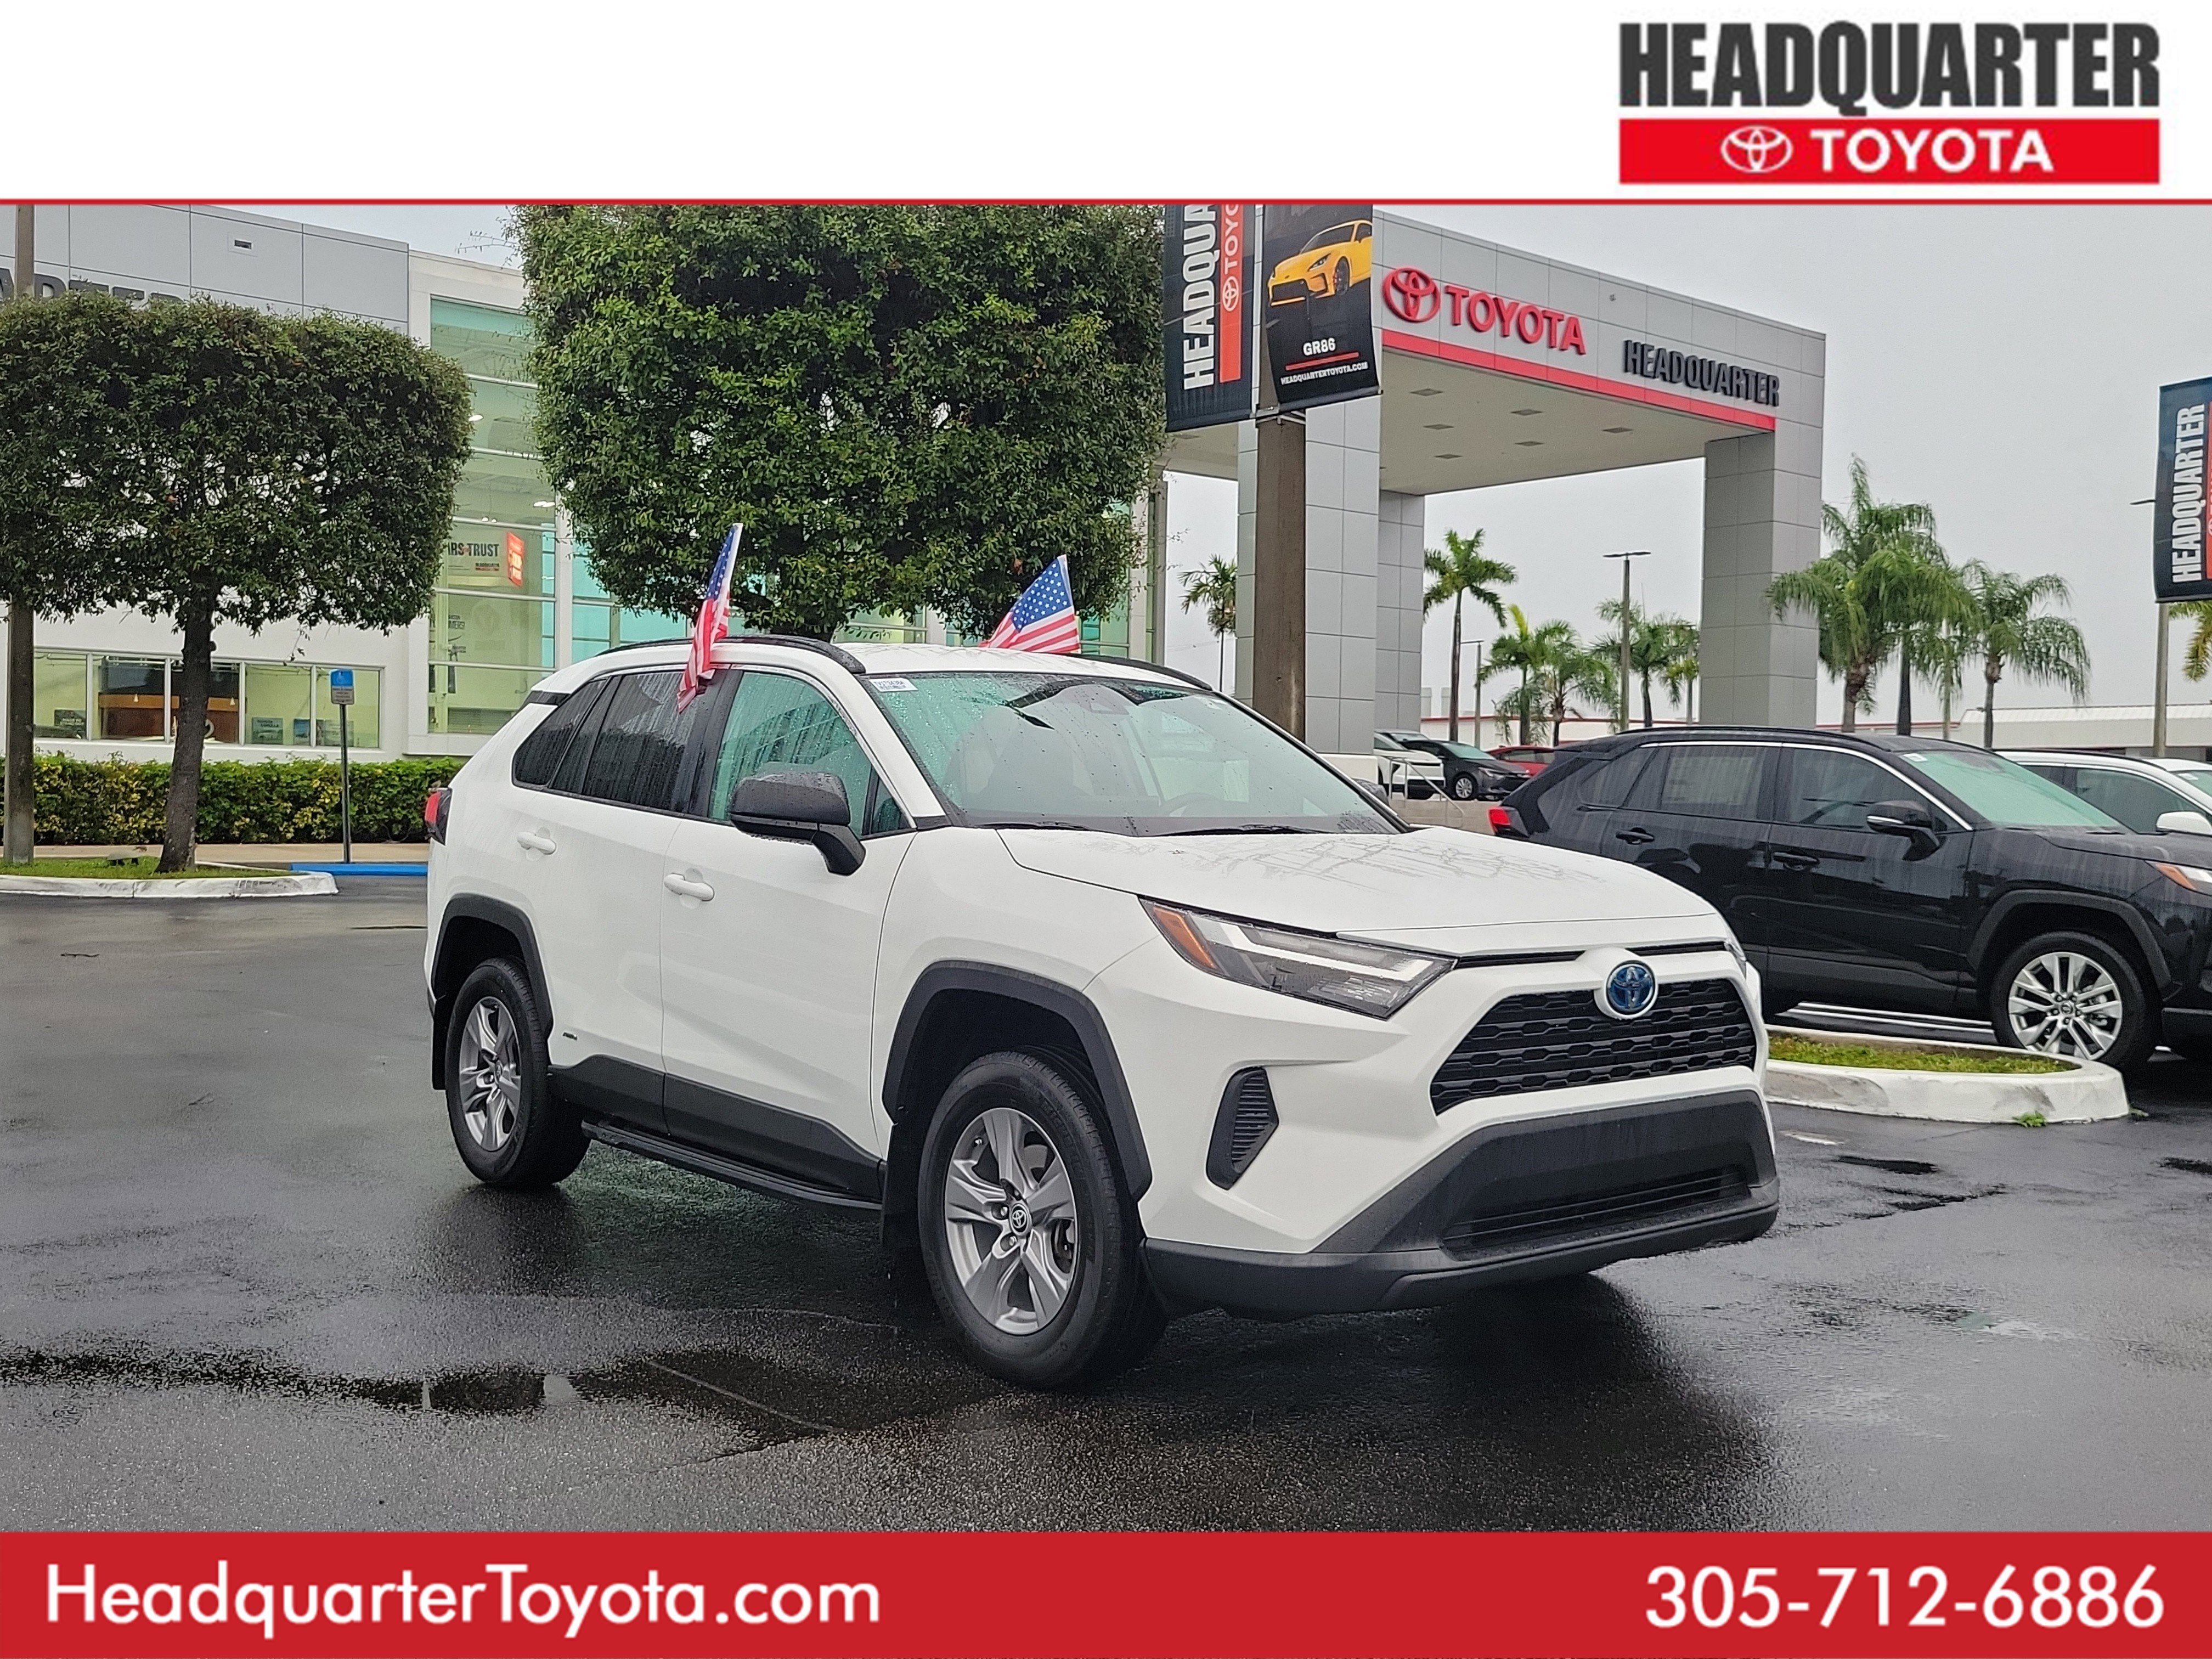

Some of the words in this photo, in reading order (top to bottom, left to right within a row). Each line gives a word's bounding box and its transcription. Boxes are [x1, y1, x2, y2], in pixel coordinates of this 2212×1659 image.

[1444, 285, 1587, 356] TOYOTA
[1303, 337, 1336, 356] GR86
[1280, 362, 1369, 385] HEADQUARTERTOYOTA.COM
[1623, 340, 1780, 407] HEADQUARTER
[2172, 404, 2207, 583] HEADQUARTER
[467, 543, 500, 557] TRUST
